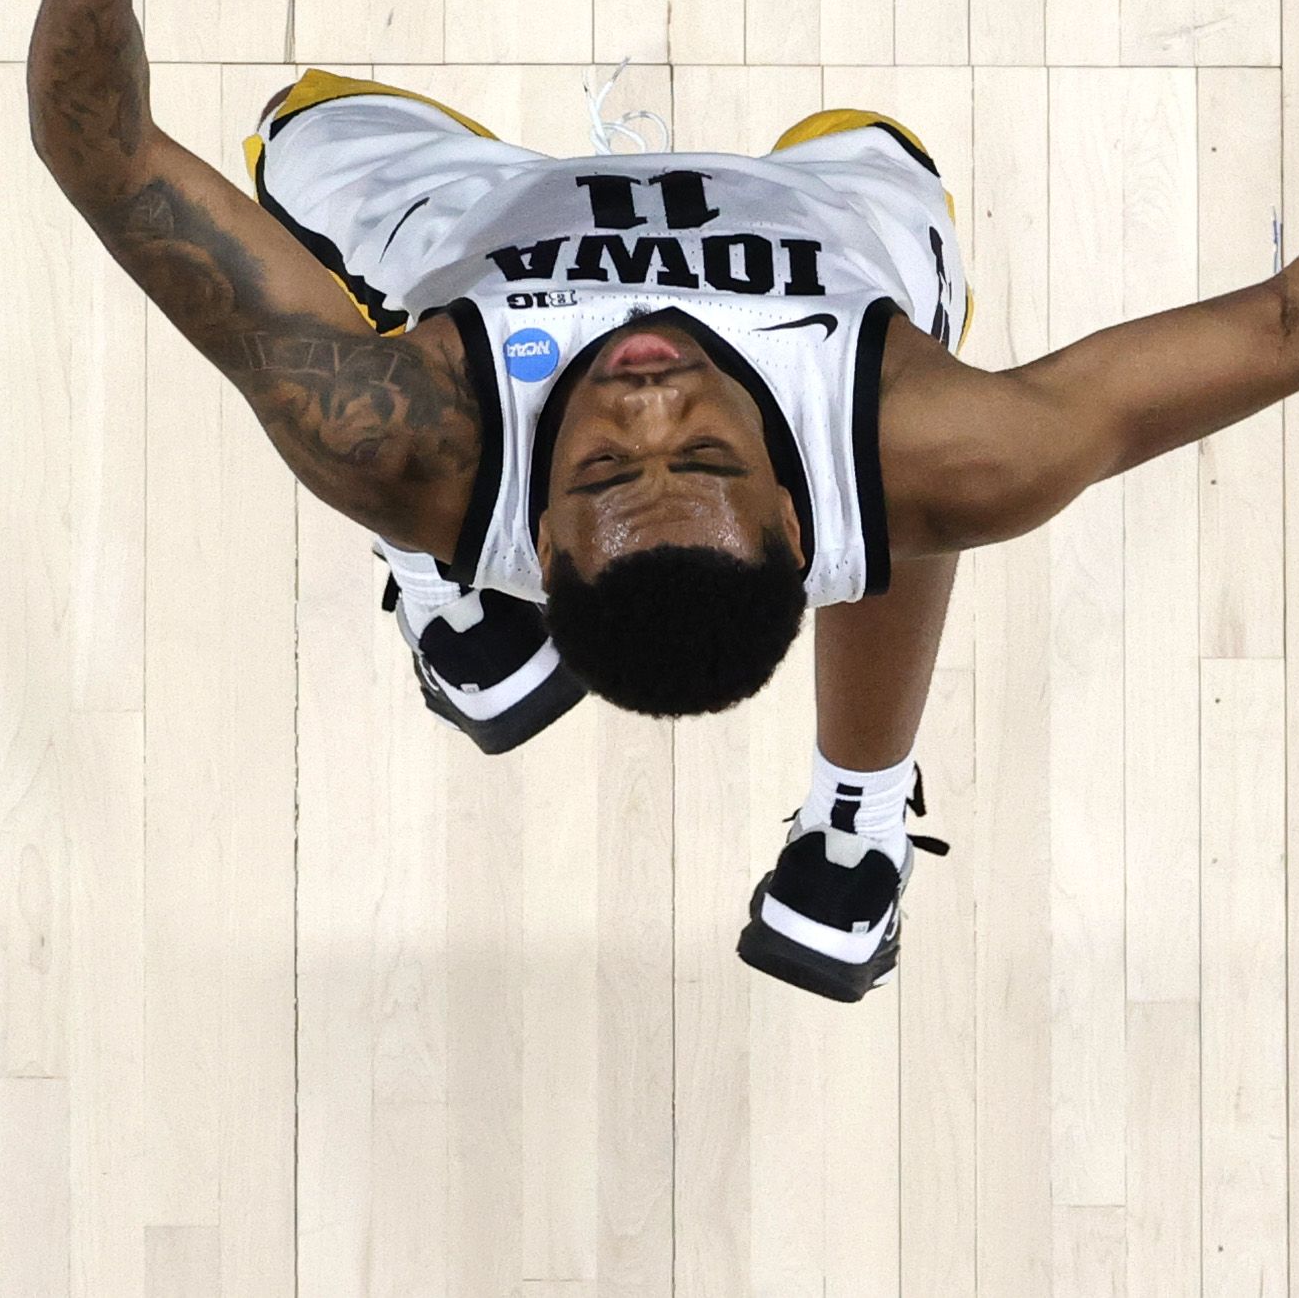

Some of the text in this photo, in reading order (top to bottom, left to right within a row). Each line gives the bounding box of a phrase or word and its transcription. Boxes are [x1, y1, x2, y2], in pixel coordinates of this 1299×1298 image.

[576, 170, 720, 230] 11
[486, 233, 826, 296] IOWA
[506, 338, 552, 358] NCAA
